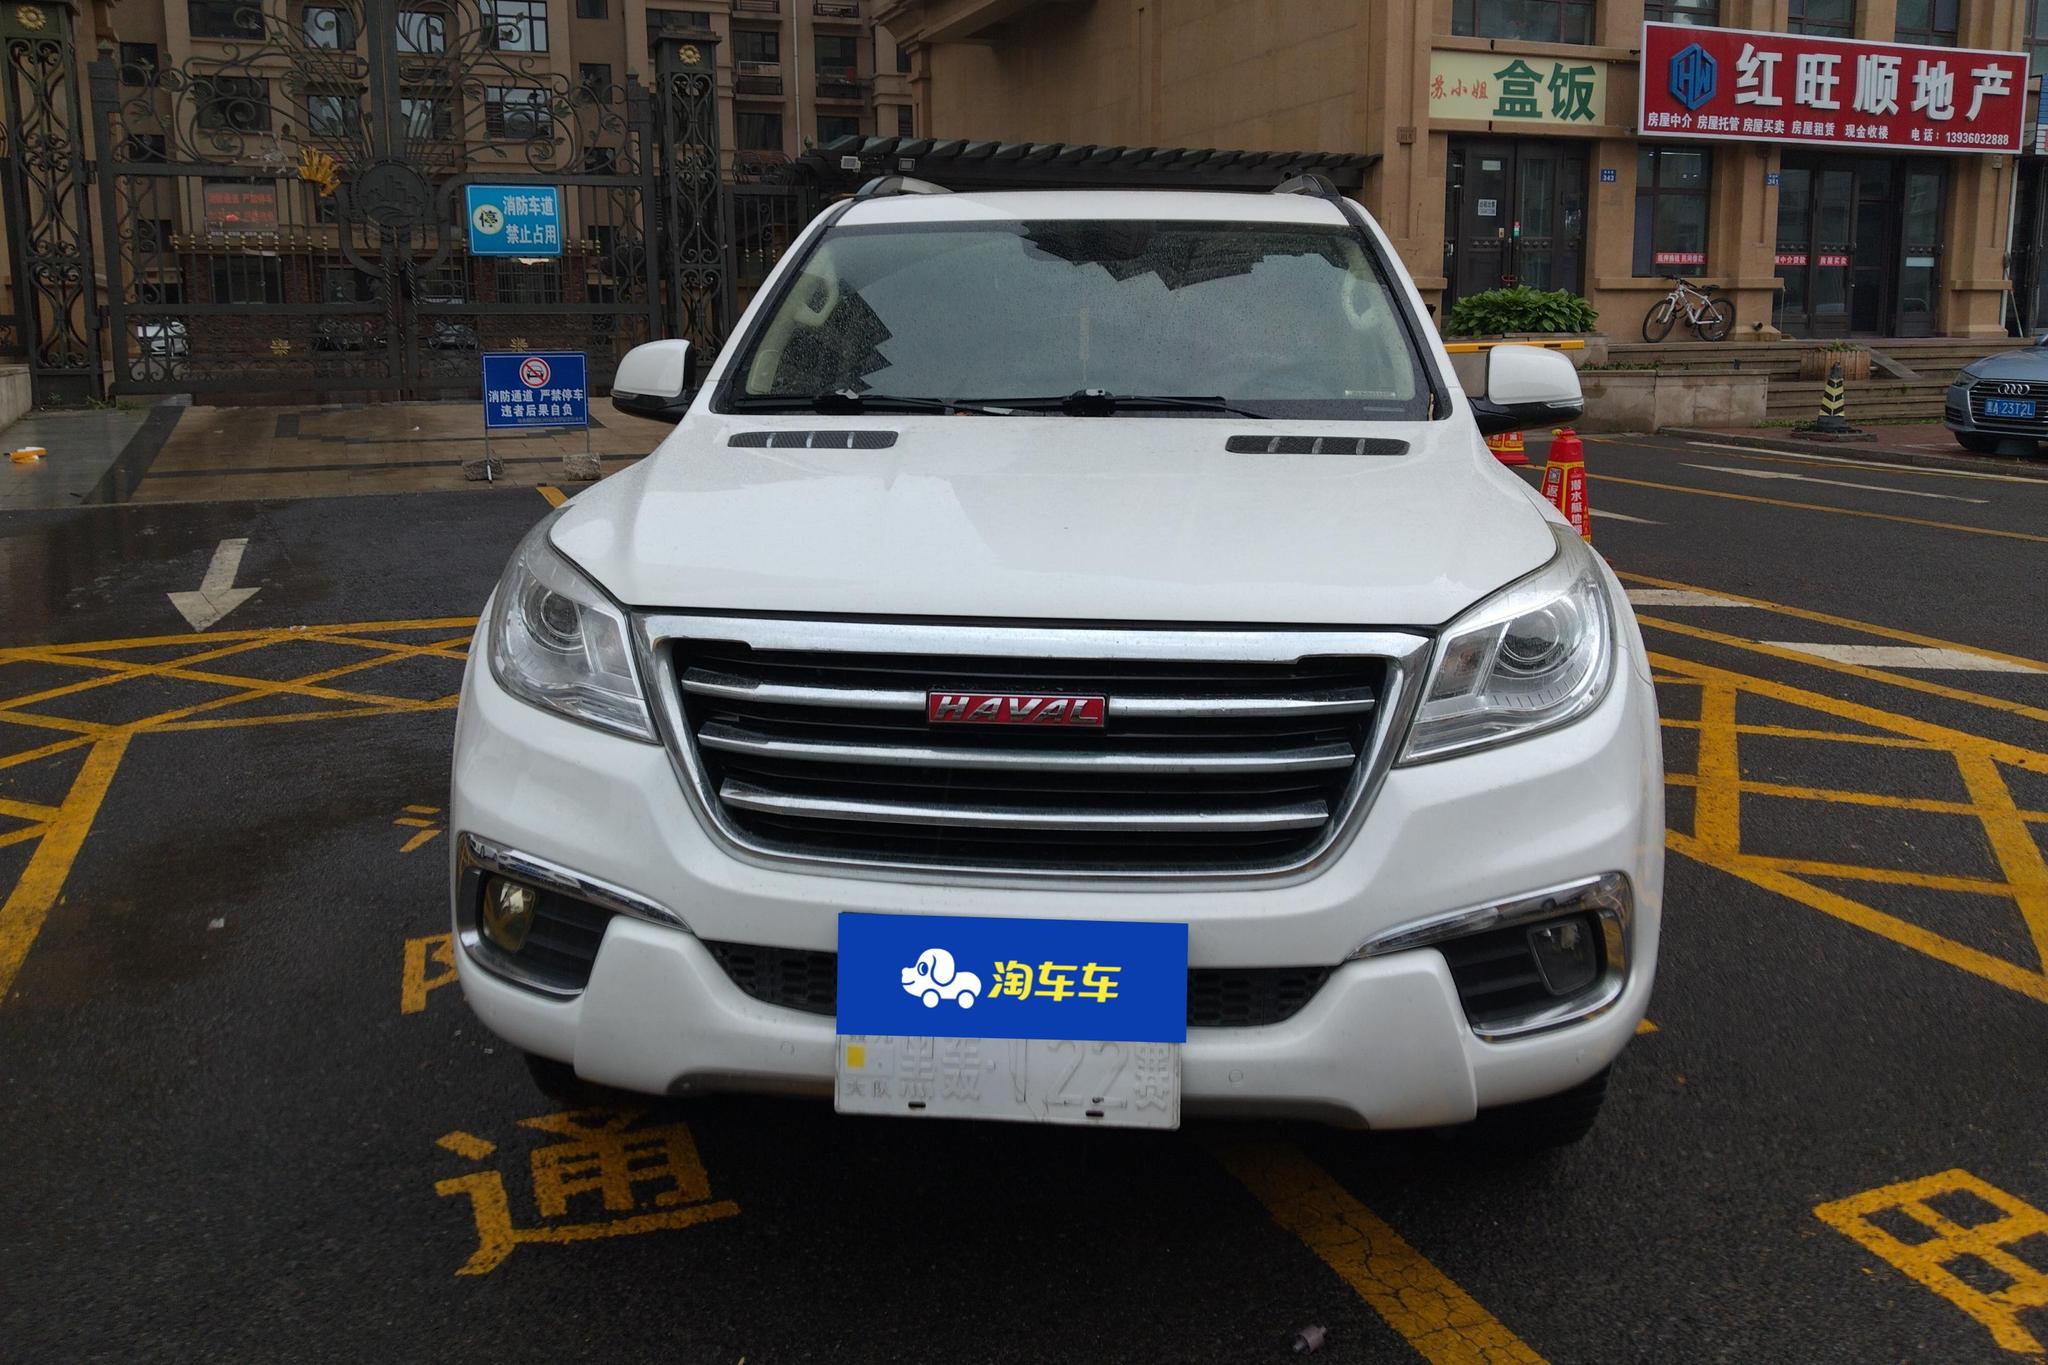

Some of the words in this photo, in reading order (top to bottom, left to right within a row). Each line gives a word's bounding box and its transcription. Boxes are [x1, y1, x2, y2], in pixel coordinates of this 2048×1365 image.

[1431, 73, 1489, 100] 苏小姐
[1493, 59, 1596, 121] 盒饭
[1735, 42, 2013, 121] 红旺顺地产
[1648, 112, 1692, 128] 房屋中介
[1697, 114, 1740, 132] 房屋托管
[1743, 117, 1785, 134] 房屋买卖
[1791, 120, 1835, 137] 房屋租赁
[1845, 124, 1889, 140] 现金收楼
[1946, 131, 2009, 145] 13936032888
[503, 195, 555, 216] 消防车道
[506, 224, 557, 244] 禁止占用
[488, 389, 533, 402] 消防通道
[540, 388, 584, 401] 严禁停车
[501, 403, 573, 417] 违者后果自负
[935, 696, 1099, 722] HAVAL
